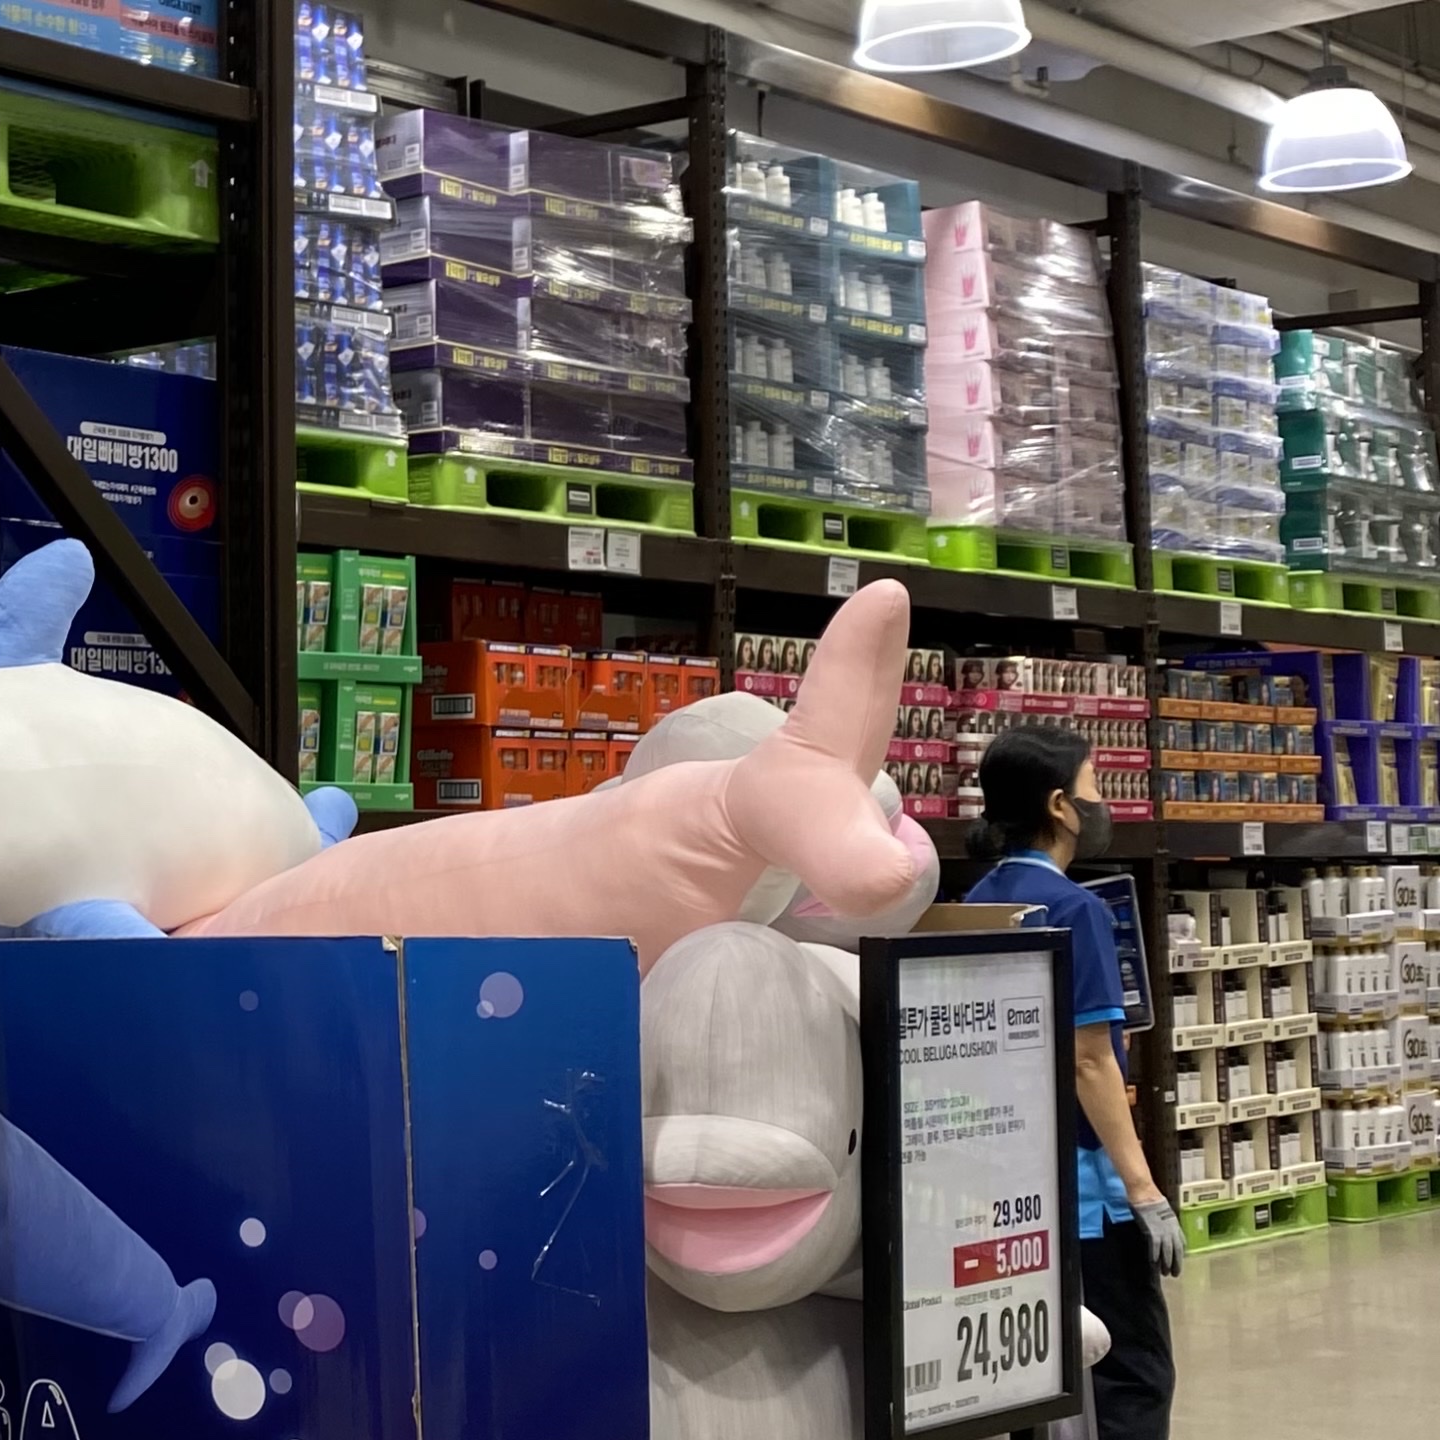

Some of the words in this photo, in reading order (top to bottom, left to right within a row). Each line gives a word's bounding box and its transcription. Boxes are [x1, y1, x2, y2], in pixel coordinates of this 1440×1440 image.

[930, 1003, 952, 1036] 쿨링
[953, 999, 997, 1034] 바디쿠션
[1007, 1006, 1040, 1026] emart
[923, 1045, 959, 1063] BELUGA
[960, 1040, 998, 1059] CUSHION
[993, 1193, 1042, 1229] 29,980
[996, 1236, 1042, 1276] 5,000
[957, 1299, 1049, 1384] 24,980
